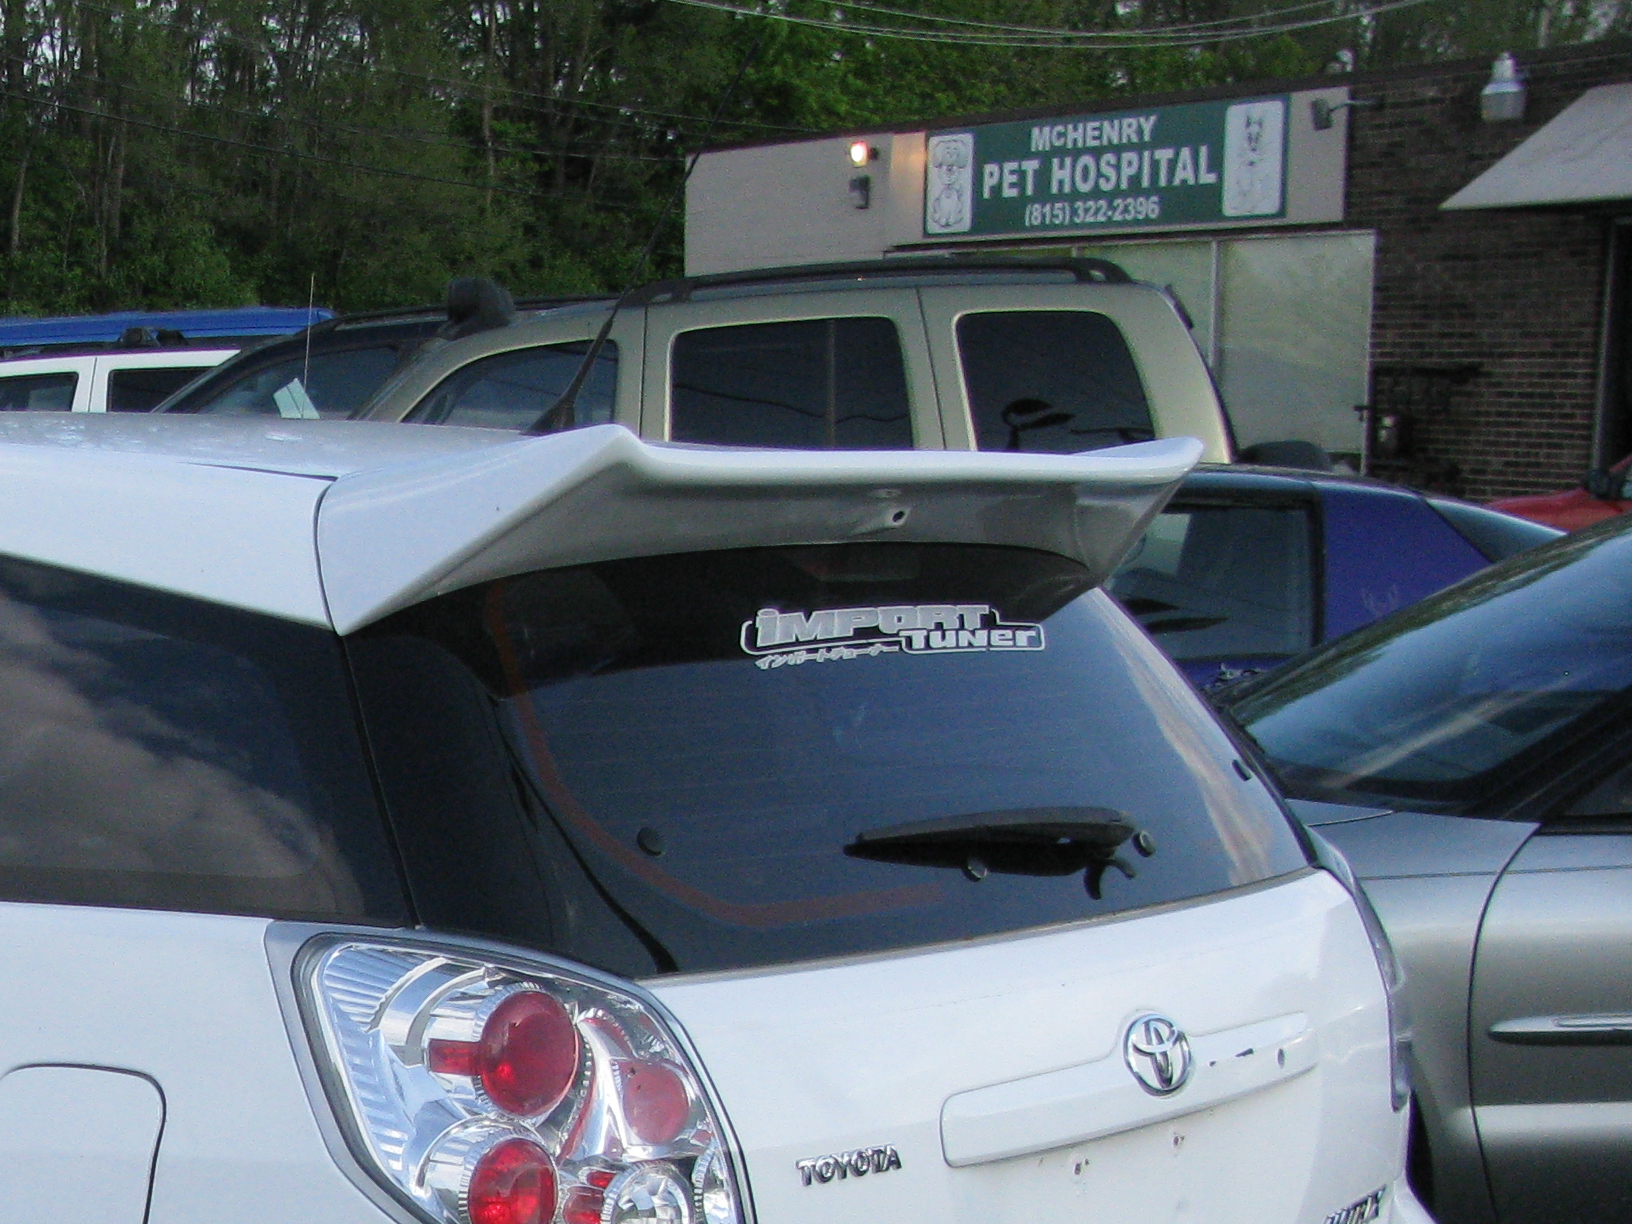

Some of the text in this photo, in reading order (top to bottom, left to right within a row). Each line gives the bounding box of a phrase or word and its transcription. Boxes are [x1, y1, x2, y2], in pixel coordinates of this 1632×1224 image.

[981, 144, 1218, 201] PET HOSPITAL
[1025, 195, 1159, 227] (815) 322-2396
[795, 1144, 902, 1187] TOYOTA
